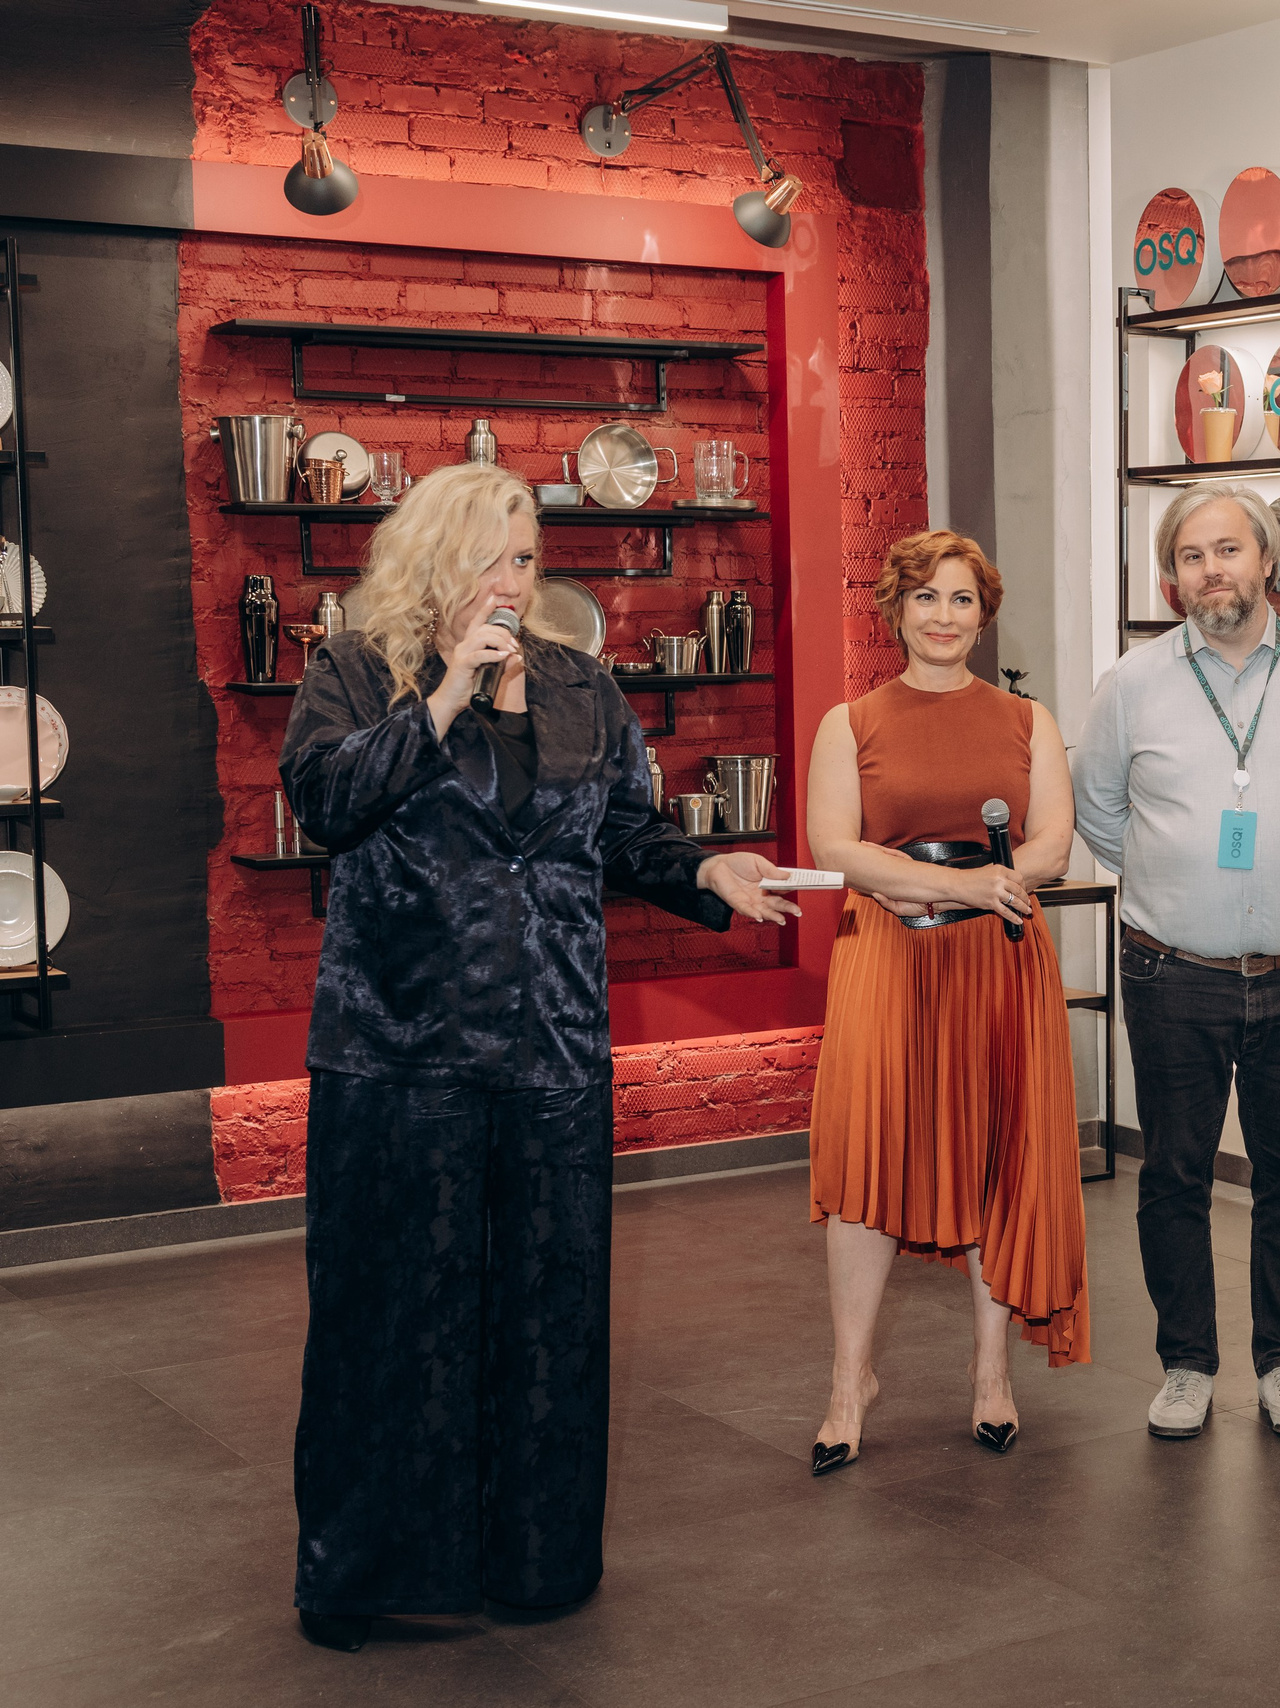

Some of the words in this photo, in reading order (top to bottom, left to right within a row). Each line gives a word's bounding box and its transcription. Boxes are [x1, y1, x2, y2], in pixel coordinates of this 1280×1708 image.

[1136, 227, 1197, 276] OSQ
[1191, 661, 1207, 686] GROUP
[1231, 831, 1244, 858] OSQ
